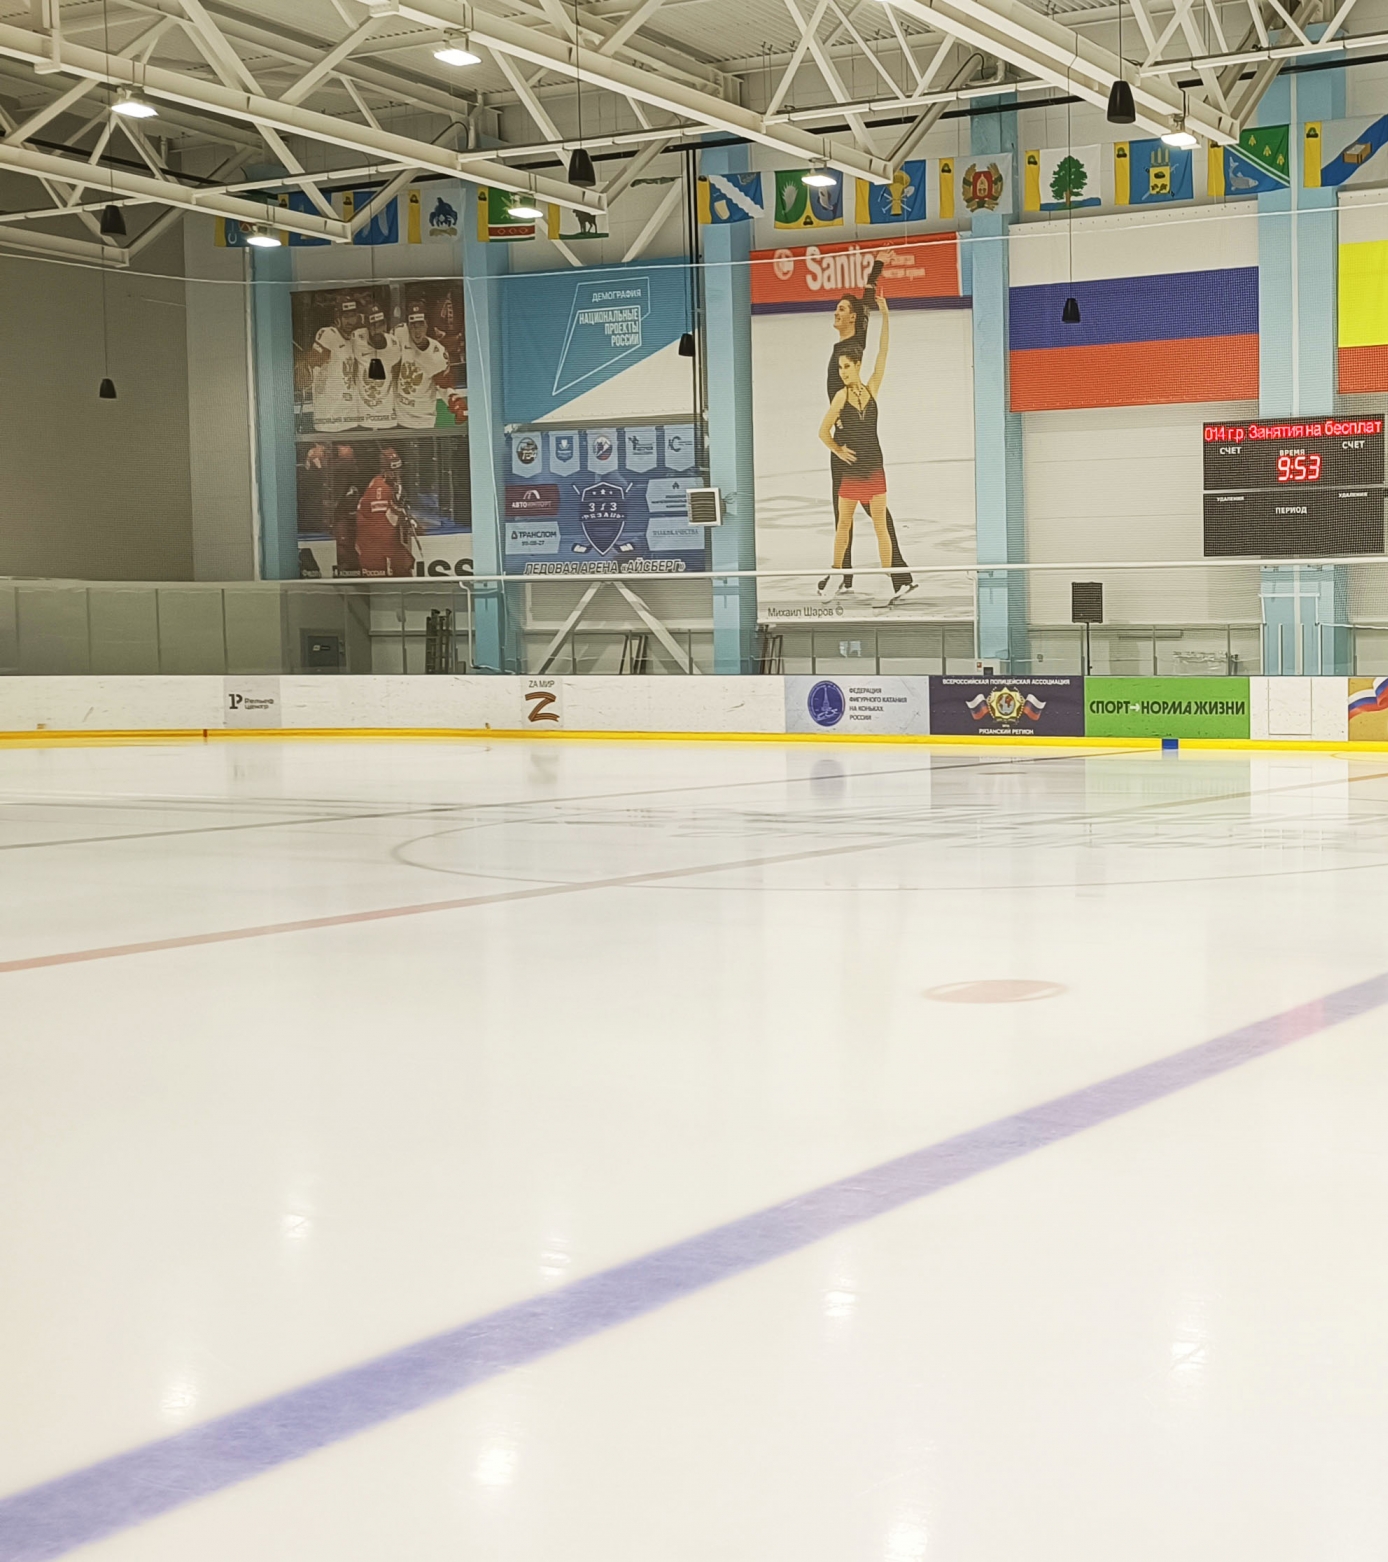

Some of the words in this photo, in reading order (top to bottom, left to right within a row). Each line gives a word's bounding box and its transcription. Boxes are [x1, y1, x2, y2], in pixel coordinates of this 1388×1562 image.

[806, 245, 875, 291] Sanita
[592, 289, 641, 302] ДЕМОГРАФИЯ
[579, 308, 638, 325] НАЦИОНАЛЬНЫЕ
[605, 321, 638, 335] ПРОЕКТЫ
[611, 333, 639, 347] РОССИИ
[1204, 427, 1225, 441] 014
[1249, 425, 1303, 439] Занятия
[1305, 426, 1322, 437] на
[1324, 420, 1382, 435] бесплат
[1219, 447, 1242, 455] СЧЕТ
[1342, 440, 1365, 449] СЧЕТ
[1277, 455, 1322, 481] 9:53
[1275, 506, 1308, 515] ПЕРИОД
[524, 562, 579, 575] ЛЕДОВАЯ
[580, 561, 618, 574] АРЕНА
[767, 607, 802, 617] Михаил
[804, 607, 833, 618] Шаров
[1089, 701, 1131, 714] СПОРТ
[1141, 700, 1192, 714] НОРМА
[1193, 701, 1246, 715] ЖИЗНИ
